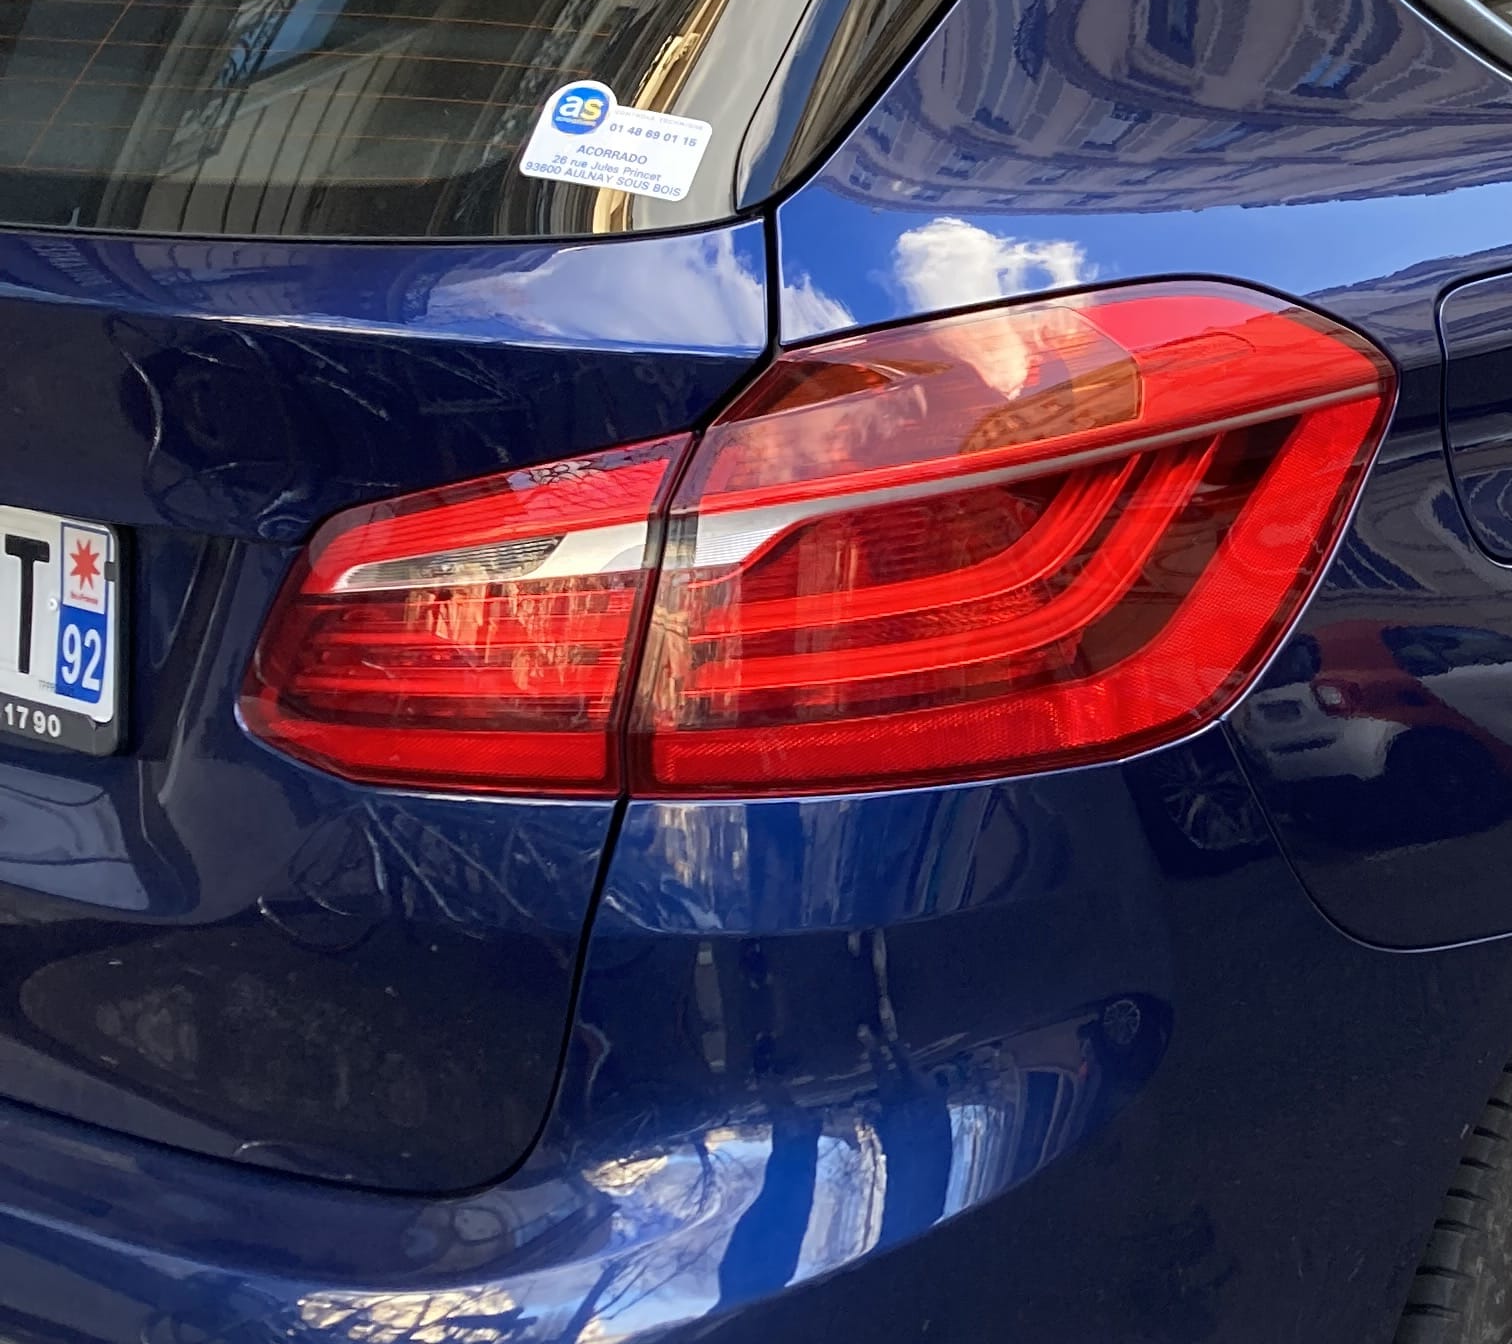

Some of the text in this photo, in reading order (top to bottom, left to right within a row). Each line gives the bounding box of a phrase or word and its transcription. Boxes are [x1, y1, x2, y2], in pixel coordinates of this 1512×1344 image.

[559, 95, 603, 121] as
[609, 122, 623, 133] 01
[627, 126, 642, 137] 48
[645, 129, 660, 140] 69
[663, 132, 678, 144] 01
[552, 154, 662, 182] 26 rue Jules Princet
[576, 144, 648, 165] ACORRADO
[525, 161, 682, 197] 93600 AULNAY SOUS BOIS
[4, 533, 50, 675] T
[61, 623, 102, 692] 92
